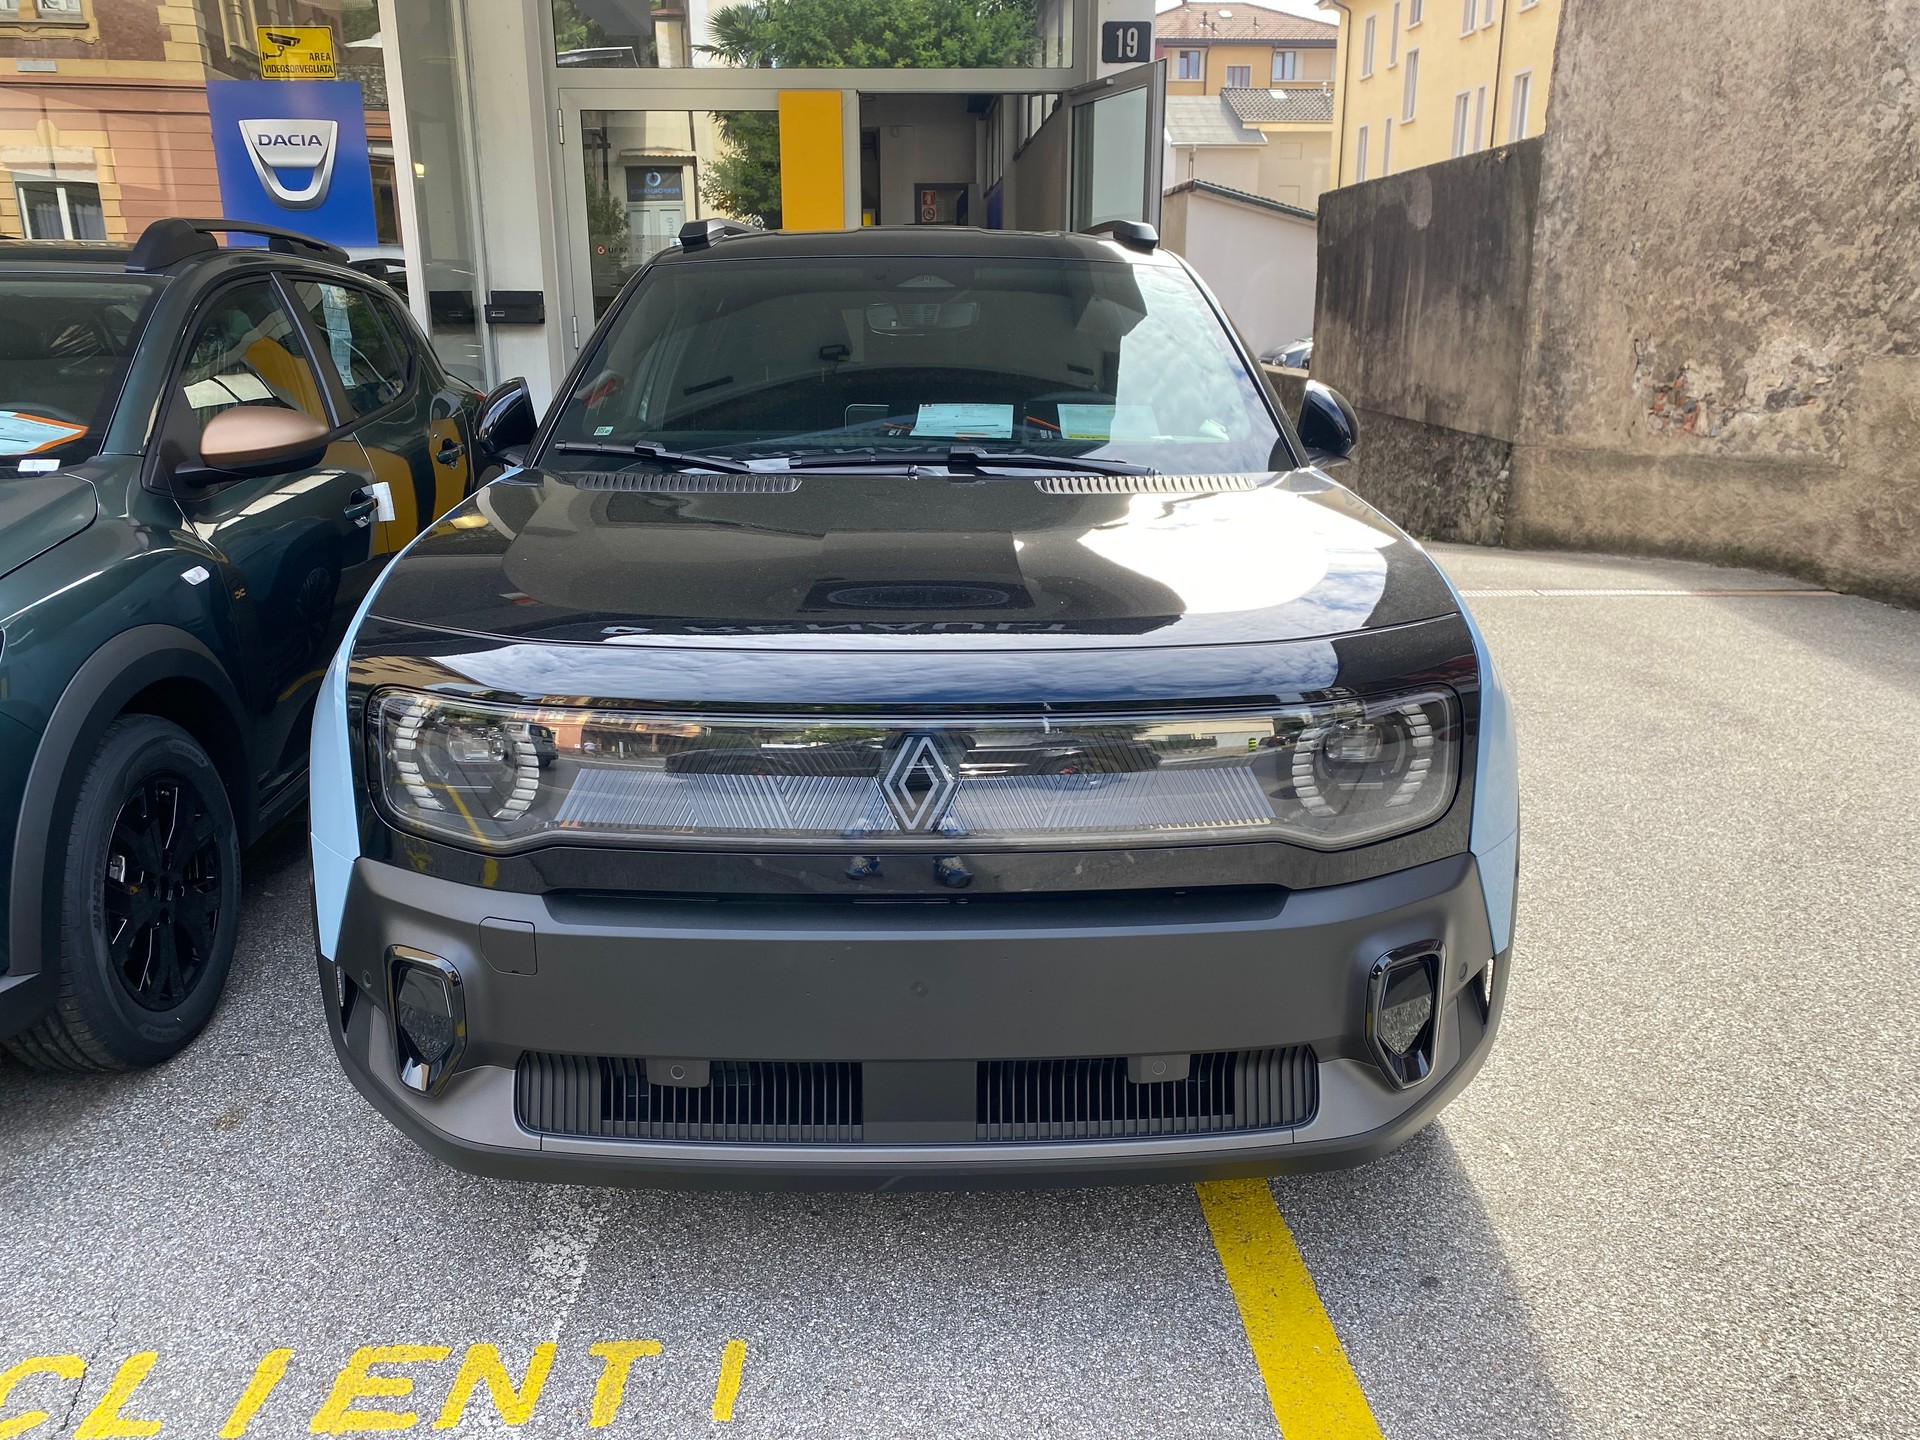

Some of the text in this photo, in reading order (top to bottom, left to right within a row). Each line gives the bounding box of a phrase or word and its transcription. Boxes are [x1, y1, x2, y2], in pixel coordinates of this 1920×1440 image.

[1116, 27, 1139, 58] 19
[309, 52, 332, 61] AREA
[264, 64, 334, 74] VIDEOSORVEGLIATA
[257, 134, 323, 147] DACIA
[0, 1340, 746, 1440] CLIENTI
